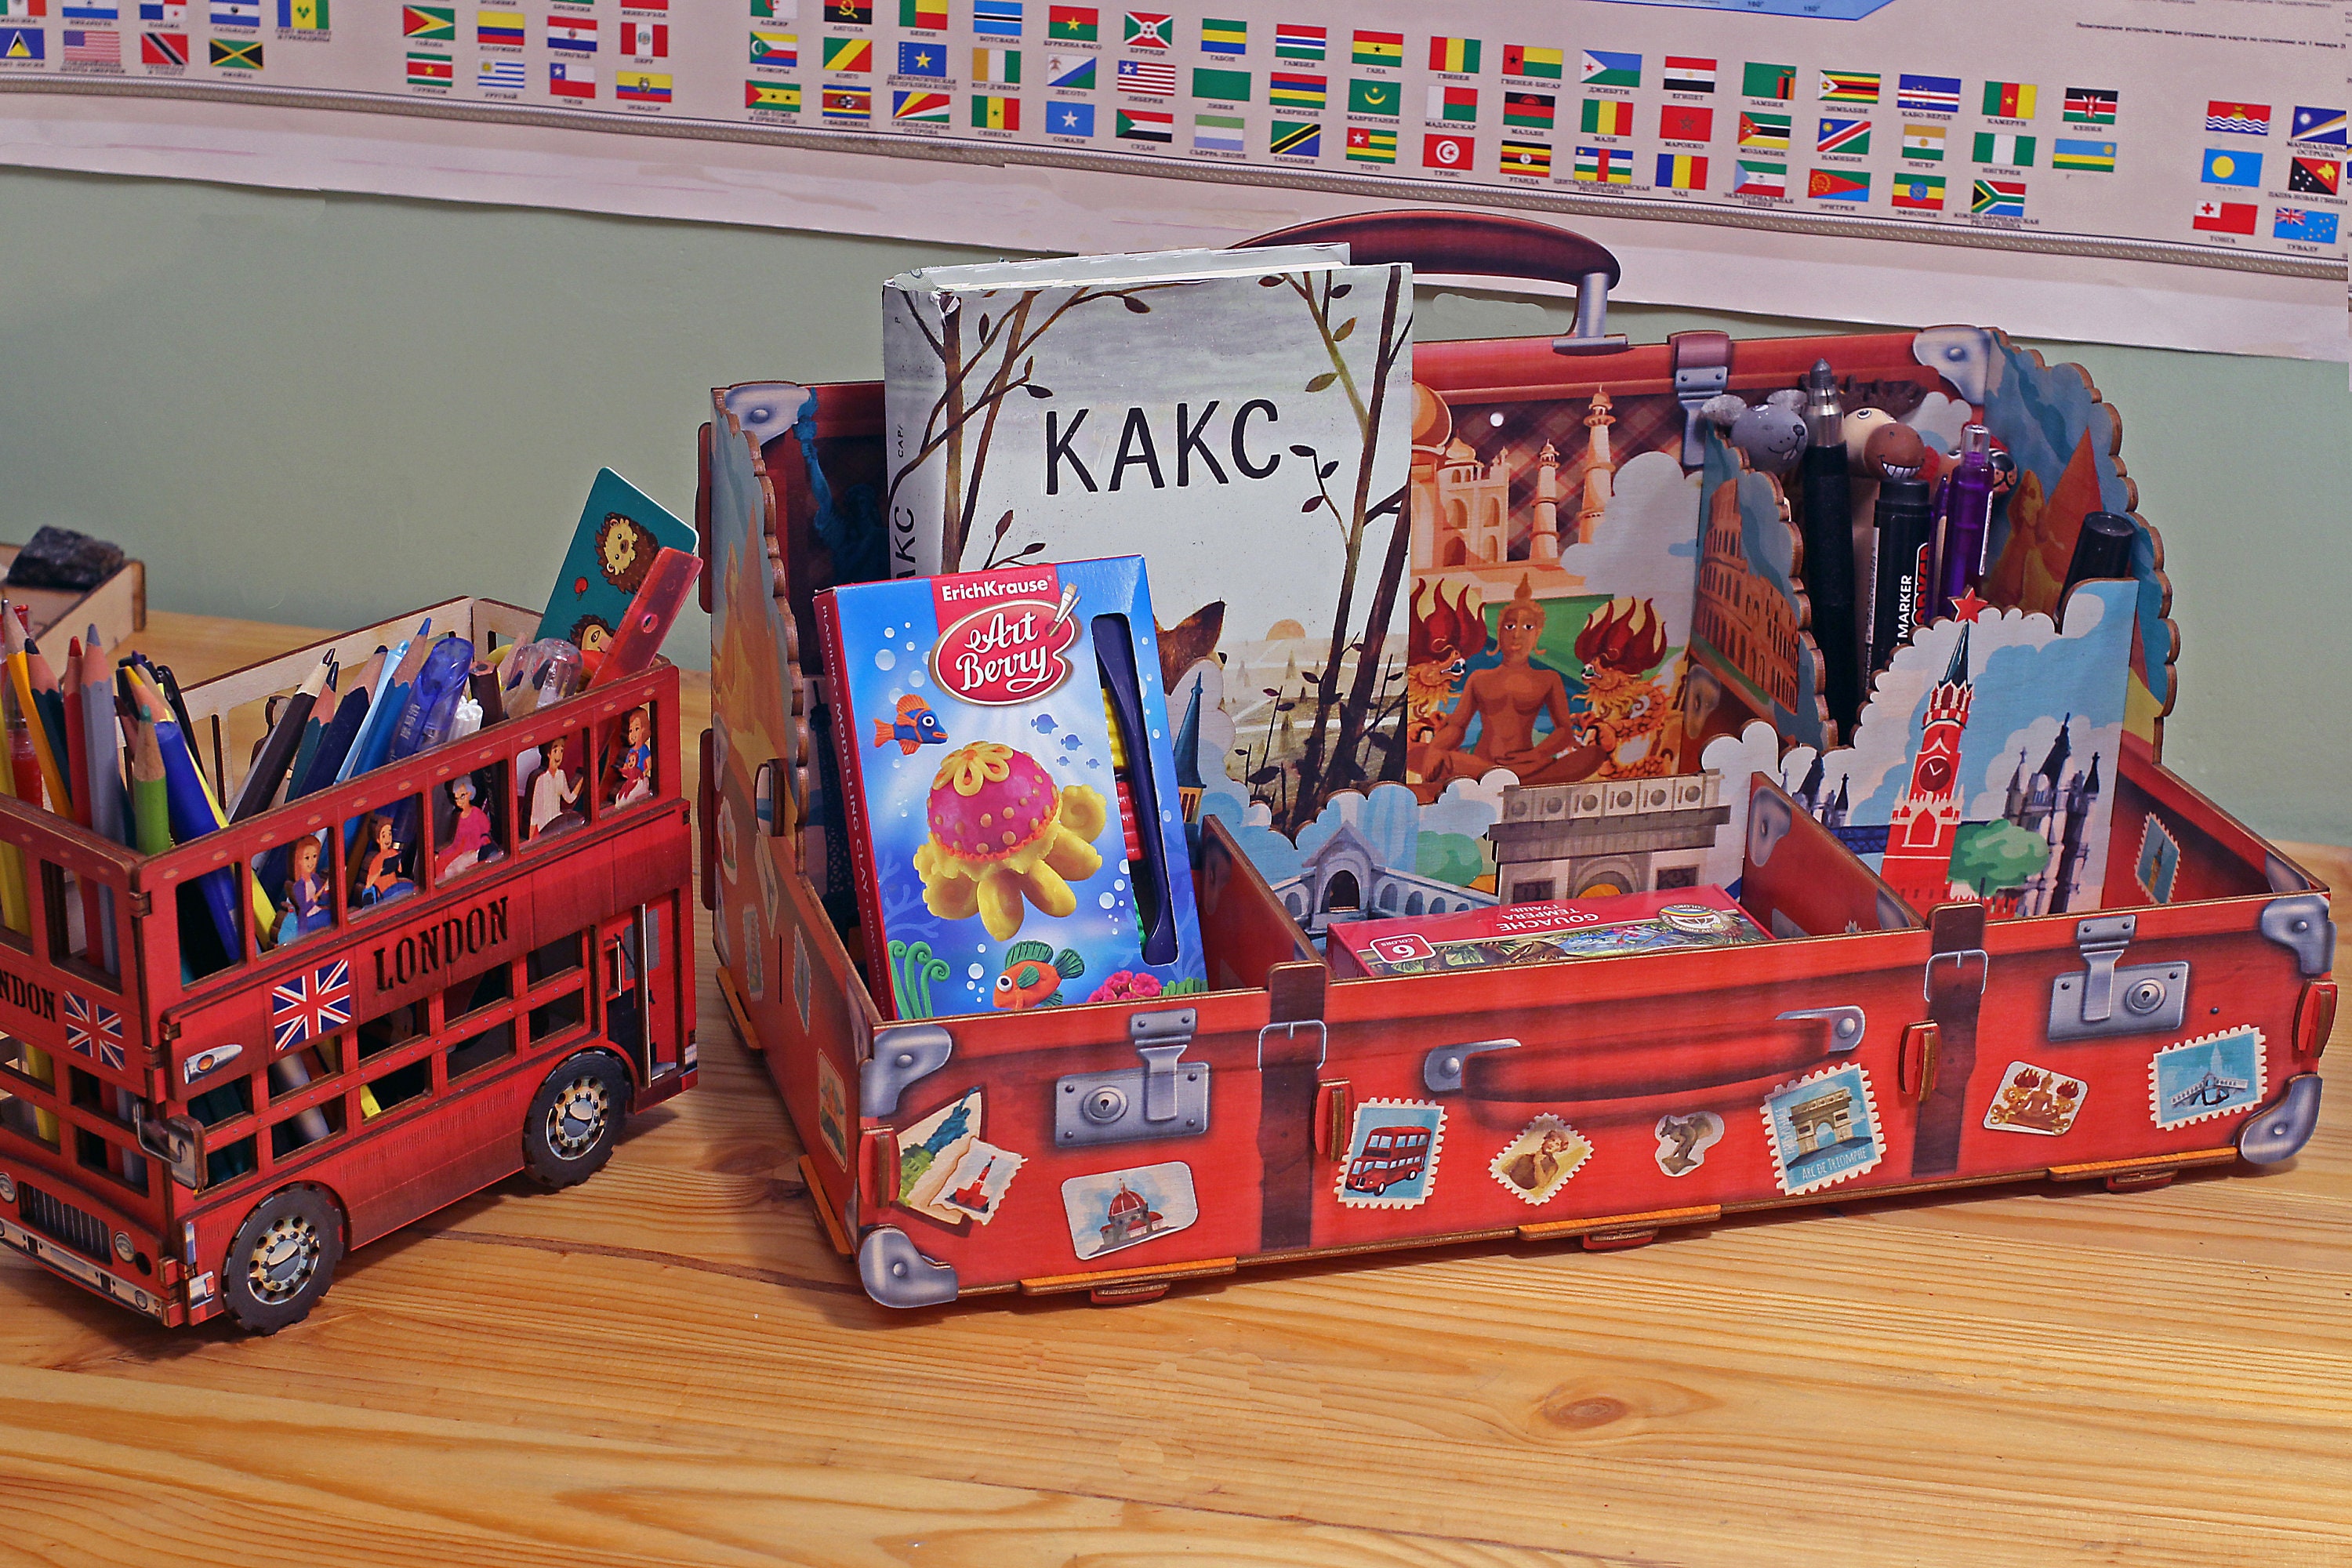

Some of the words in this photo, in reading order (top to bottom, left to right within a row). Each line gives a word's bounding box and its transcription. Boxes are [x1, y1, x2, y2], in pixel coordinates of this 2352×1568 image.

[1045, 398, 1281, 495] КАКС
[894, 506, 916, 578] КС
[942, 579, 1048, 602] ErichKrause
[1897, 575, 1912, 638] MARKER
[964, 611, 1039, 654] Art
[955, 645, 1054, 693] Berry
[822, 605, 837, 686] PLASTILINA
[836, 702, 859, 832] MODELLING
[856, 838, 869, 892] CLAY
[1496, 913, 1599, 932] GOUACHE
[1501, 907, 1581, 921] TEMPERA
[373, 896, 509, 991] LONDON
[1381, 937, 1414, 947] COLORS
[1391, 943, 1416, 959] 6
[0, 969, 56, 1022] NDON
[1802, 1167, 1815, 1181] ARC
[1817, 1162, 1828, 1175] DE
[1827, 1147, 1867, 1171] TRIOMPHE
